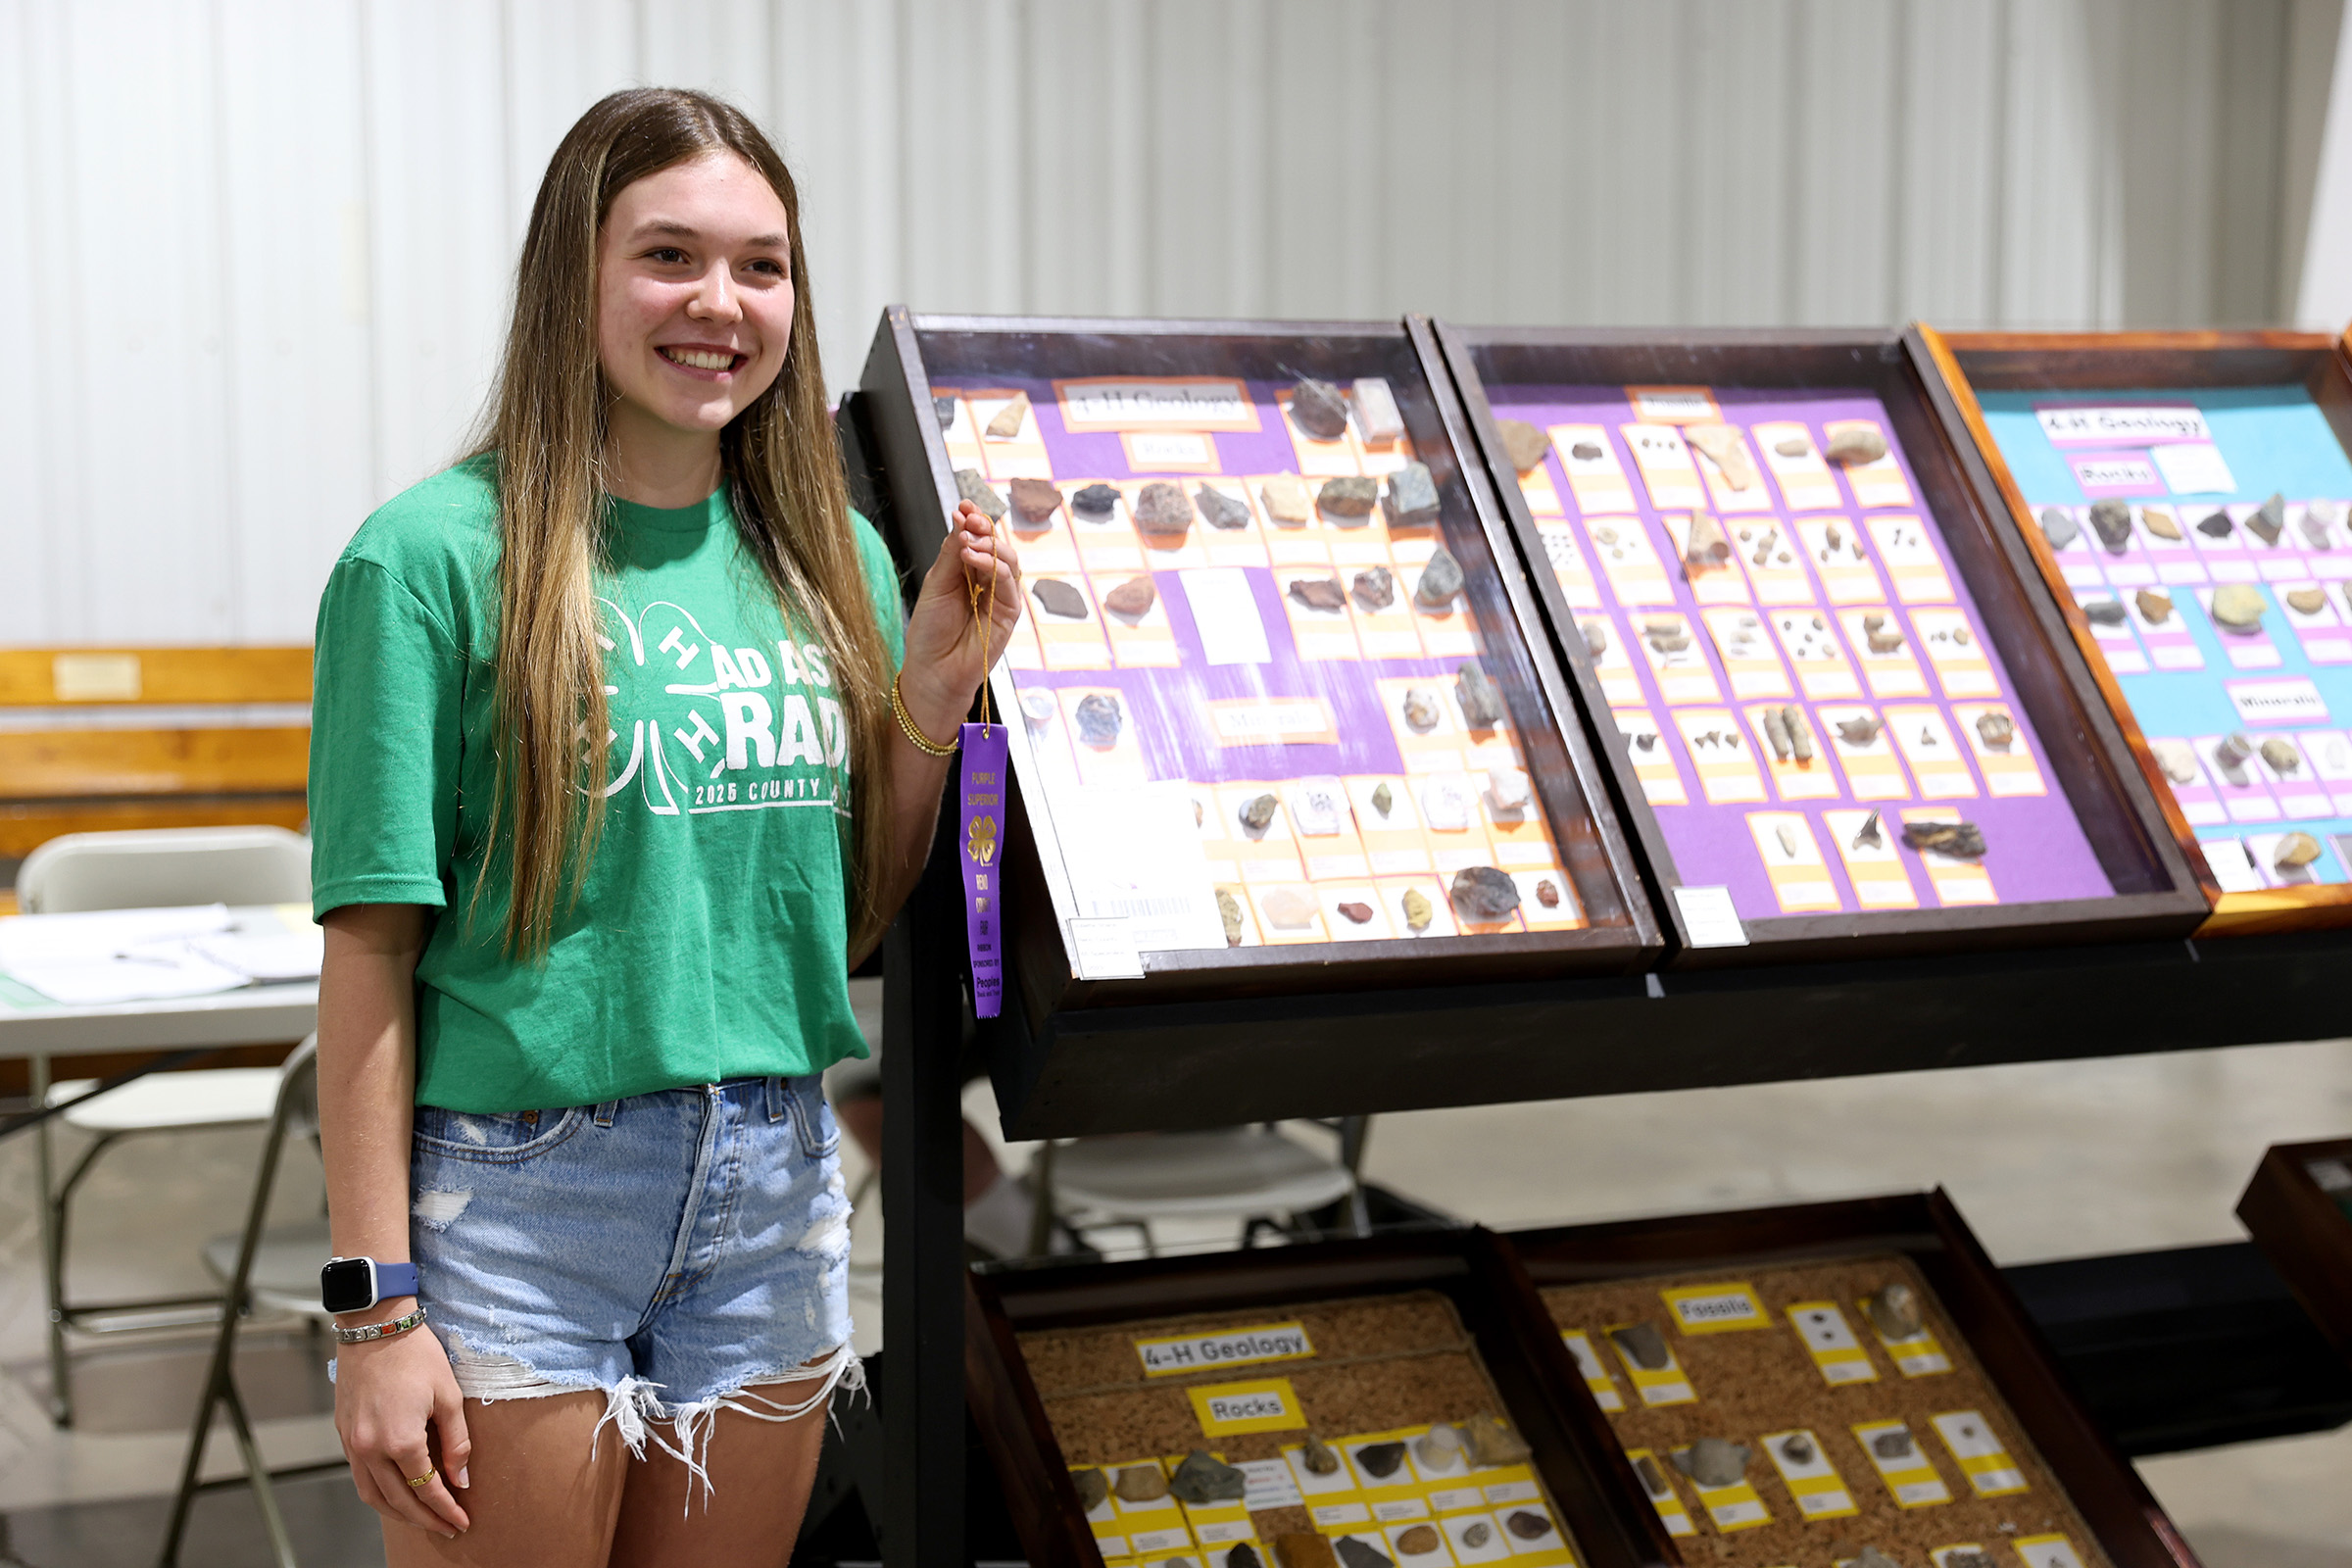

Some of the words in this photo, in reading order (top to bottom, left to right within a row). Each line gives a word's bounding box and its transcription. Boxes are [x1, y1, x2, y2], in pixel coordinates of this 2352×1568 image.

[710, 645, 772, 689] AD
[971, 772, 996, 784] PURPLE
[696, 783, 736, 805] 2025
[749, 778, 820, 800] COUNTY
[967, 793, 999, 806] SUPERIOR
[977, 977, 1000, 989] Peoples
[1678, 1298, 1754, 1318] Fossils
[1145, 1344, 1195, 1367] 4-H
[1200, 1335, 1303, 1360] Geology
[1211, 1397, 1283, 1420] Rocks
